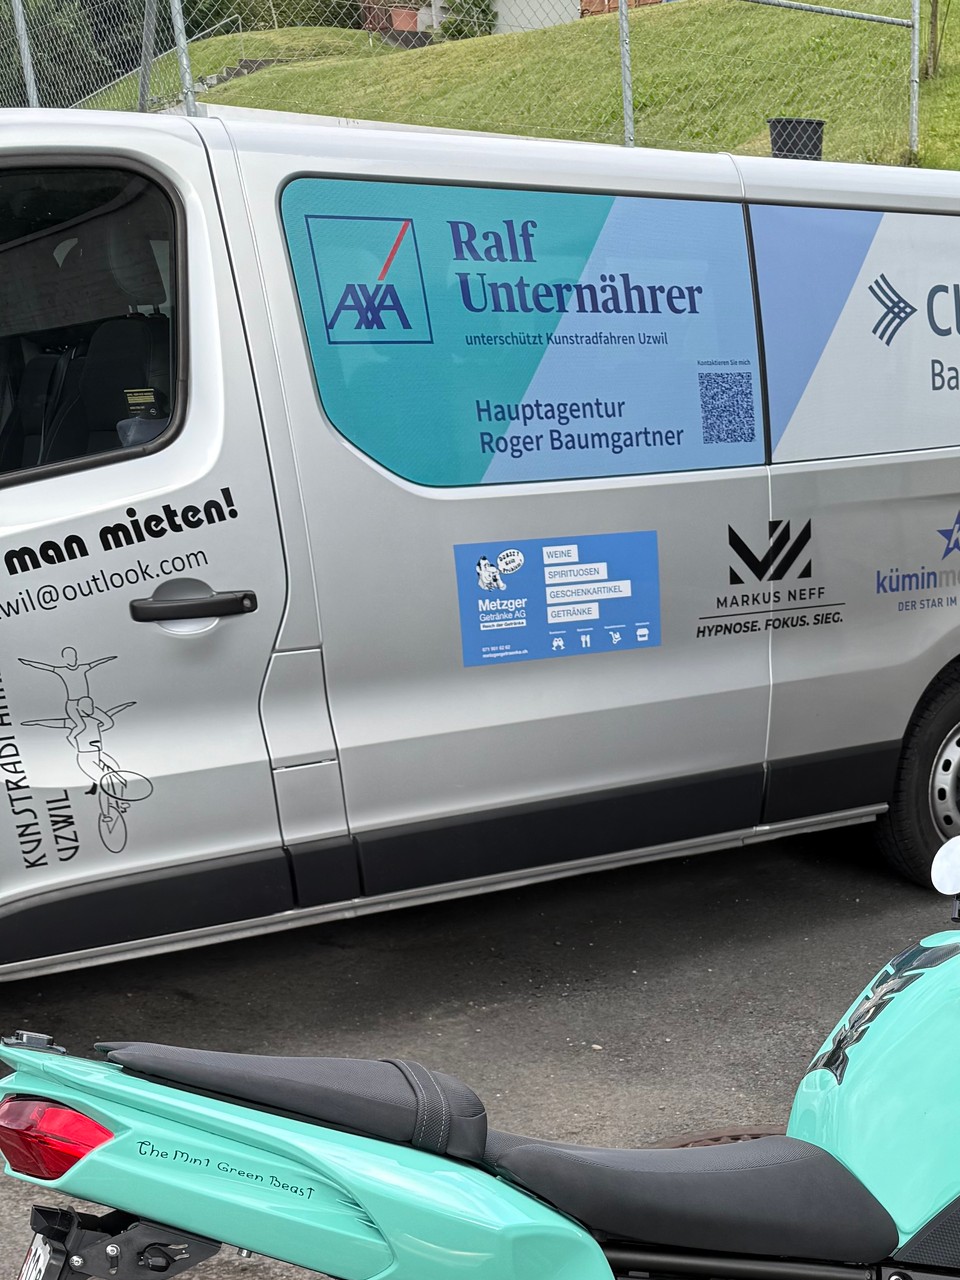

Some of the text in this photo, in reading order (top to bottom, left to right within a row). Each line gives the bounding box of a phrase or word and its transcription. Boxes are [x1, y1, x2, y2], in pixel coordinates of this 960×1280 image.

[446, 219, 538, 263] Ralf
[328, 284, 412, 330] AXA
[455, 272, 703, 316] Unternährer
[465, 331, 668, 347] unterschützt Kunstradfahren Uzwil
[475, 398, 626, 425] Hauptagentur
[479, 427, 684, 458] Roger Baumgartner
[4, 487, 239, 576] man mieten!
[546, 550, 572, 559] WEINE
[0, 550, 209, 619] wil@outlook.com
[548, 568, 600, 579] SPIRITUOSEN
[478, 598, 527, 611] Metzger
[549, 585, 623, 599] GESCHENKARTIKEL
[716, 587, 826, 609] MARKUS NEFF
[897, 601, 917, 612] DER
[919, 598, 944, 609] STAR
[946, 597, 958, 607] IM
[479, 610, 526, 621] Getränke AG
[550, 607, 592, 618] GETRÄNKE
[695, 611, 844, 638] HYPNOSE. FOKUS. SIEG.
[46, 789, 80, 862] UZWIL
[137, 1141, 169, 1159] The
[217, 1162, 264, 1182] Green
